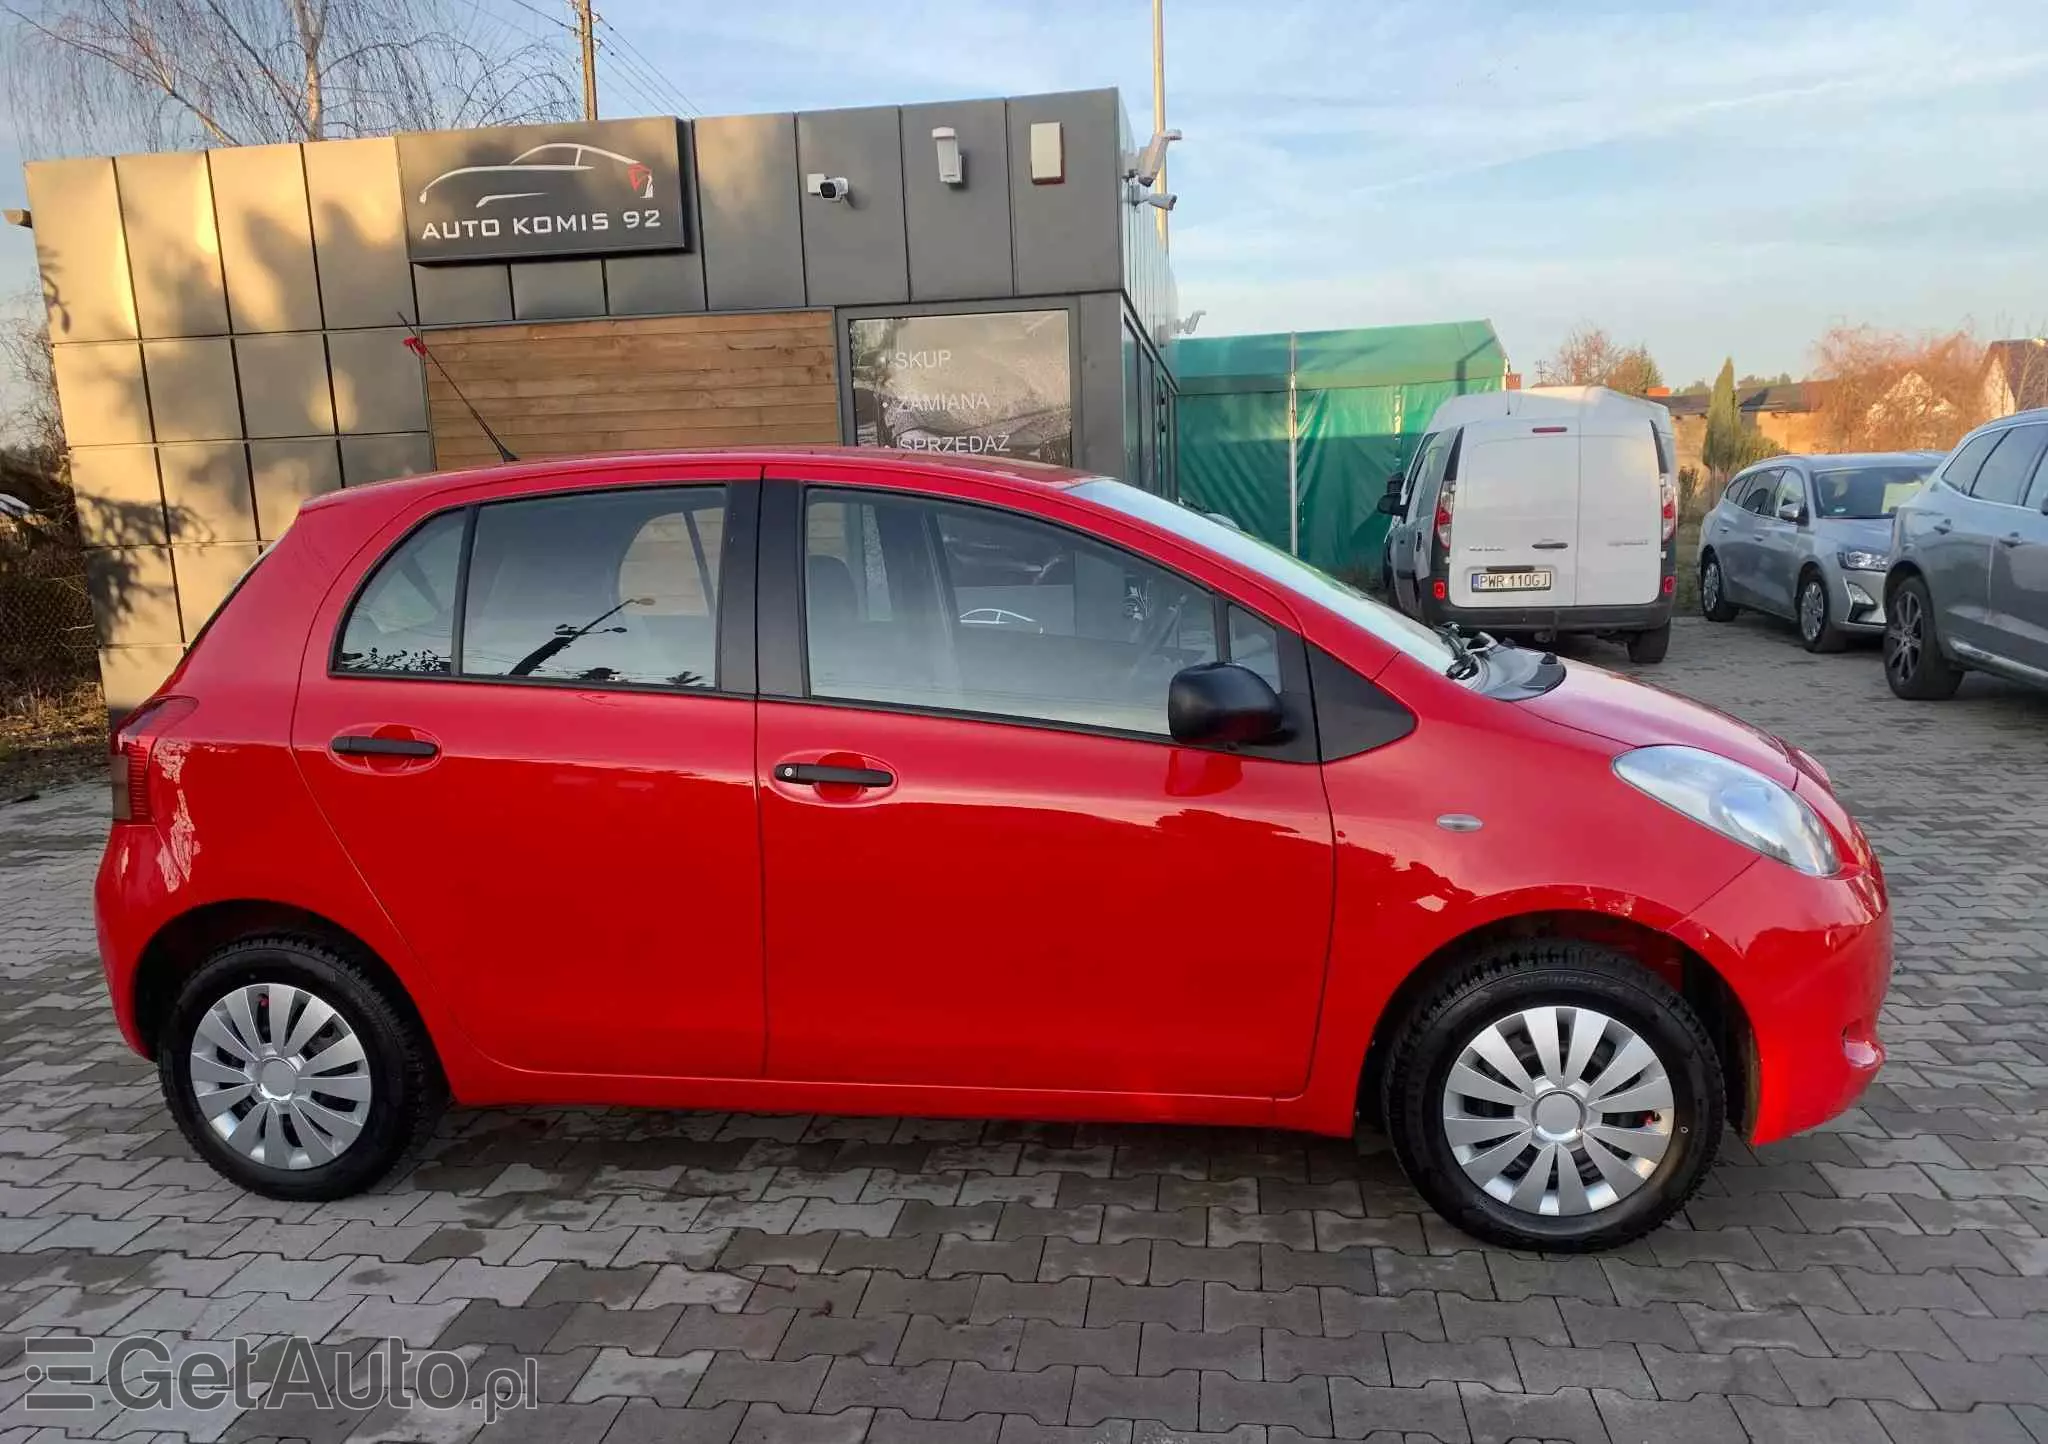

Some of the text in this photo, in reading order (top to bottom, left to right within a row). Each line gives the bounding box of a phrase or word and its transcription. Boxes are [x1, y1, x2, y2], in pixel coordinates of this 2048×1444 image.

[422, 209, 661, 240] AUTO KOMIS 92
[895, 349, 952, 370] SKUP
[899, 392, 991, 412] ZAMIANA
[1480, 574, 1505, 588] PWR
